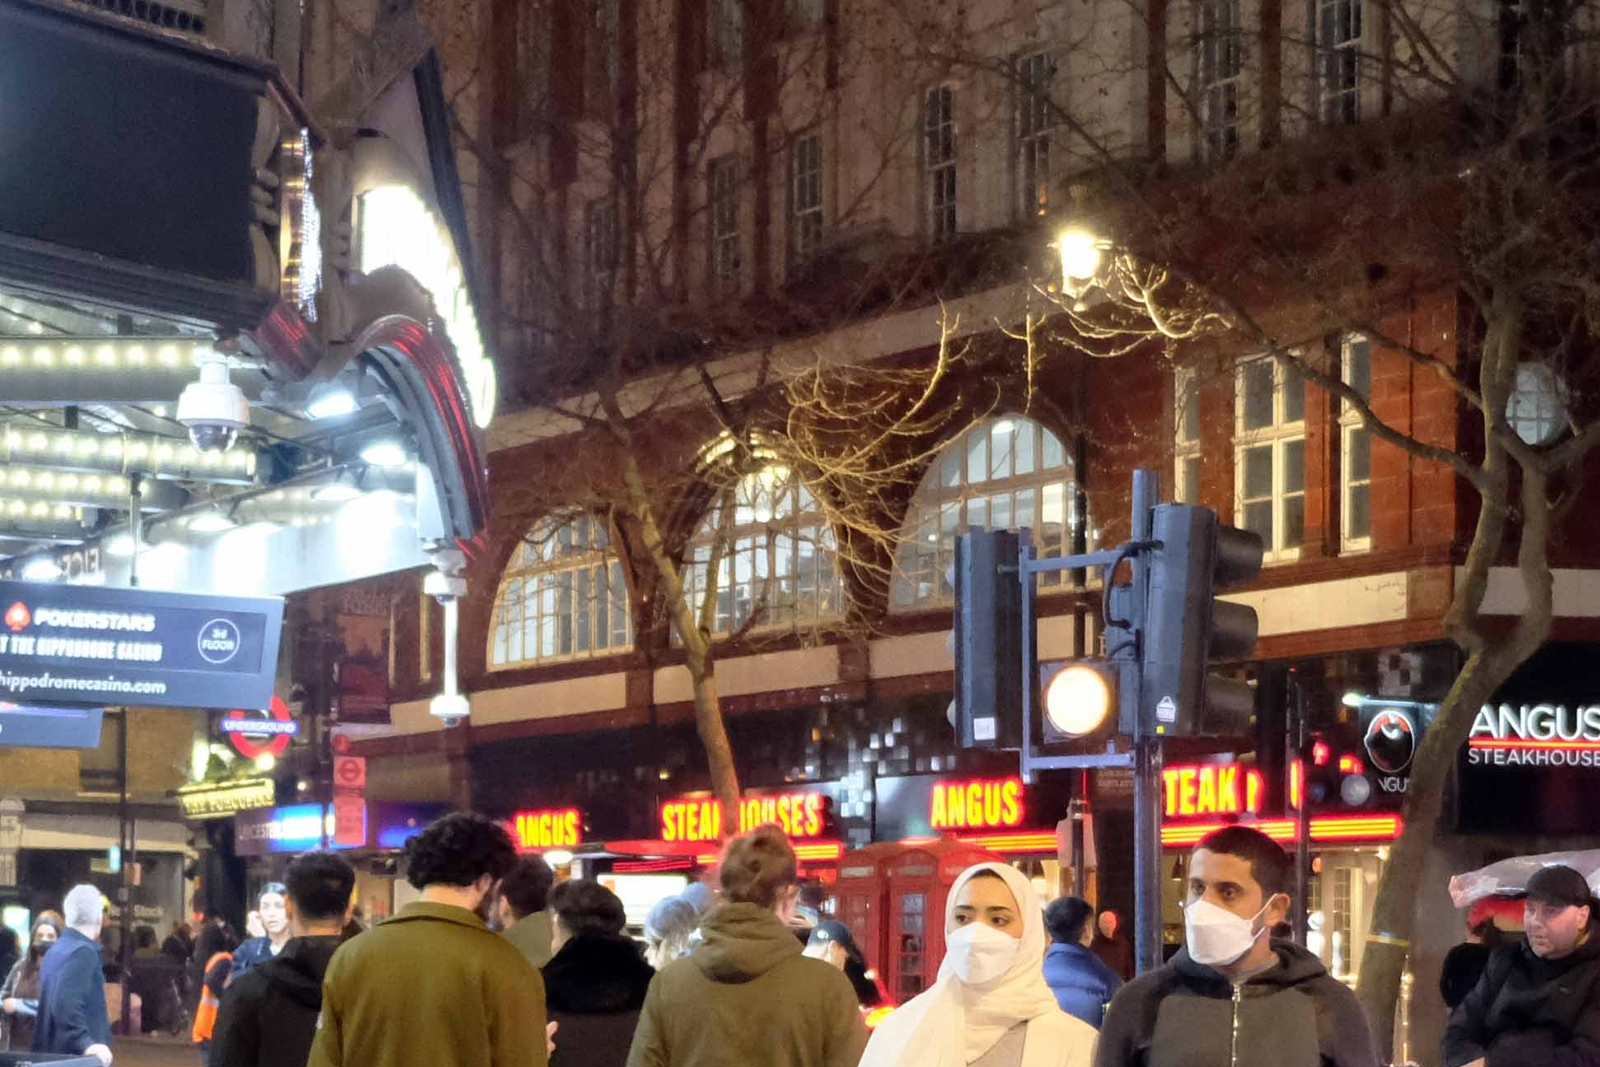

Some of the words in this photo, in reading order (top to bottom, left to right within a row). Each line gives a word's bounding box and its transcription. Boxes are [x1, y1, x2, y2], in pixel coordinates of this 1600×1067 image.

[33, 608, 156, 632] POKERSTARS
[202, 638, 235, 651] FLOOR
[223, 720, 297, 733] UNDERGROUND
[930, 782, 1020, 827] ANGUS
[1162, 767, 1237, 816] TEAK
[516, 812, 577, 847] ANGUS
